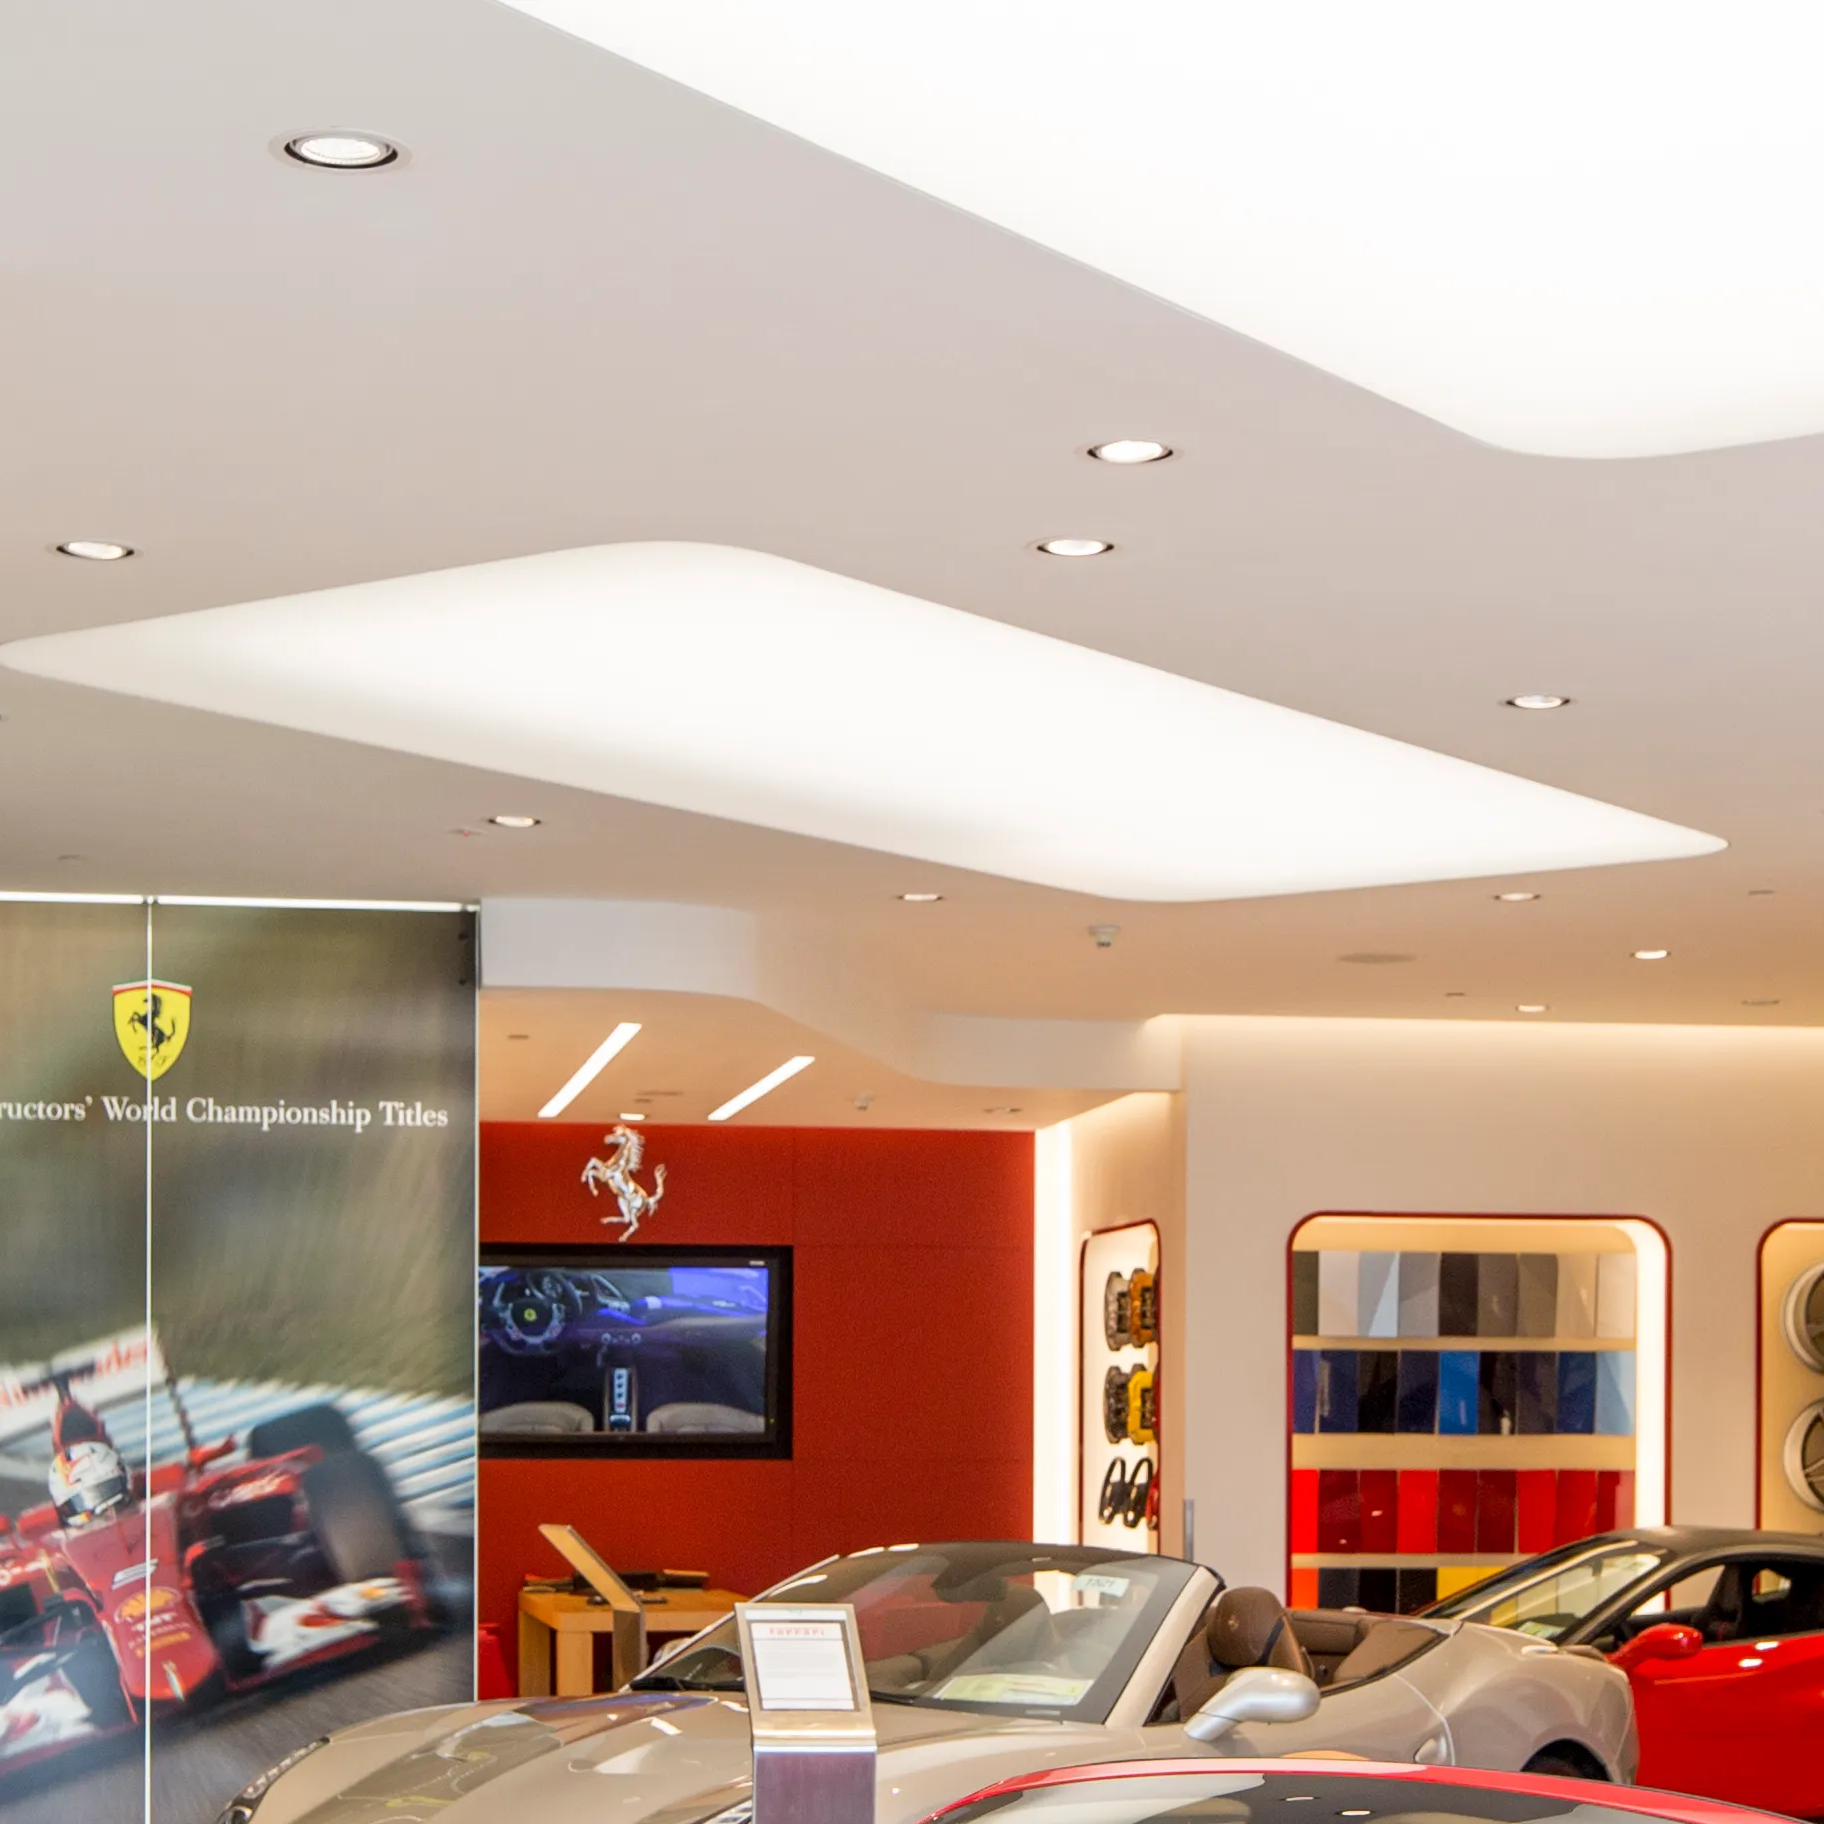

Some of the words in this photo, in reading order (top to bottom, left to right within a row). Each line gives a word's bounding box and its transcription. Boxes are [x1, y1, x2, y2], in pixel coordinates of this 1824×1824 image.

[100, 1095, 177, 1123] World
[185, 1096, 372, 1134] Championship
[378, 1100, 449, 1128] Titles
